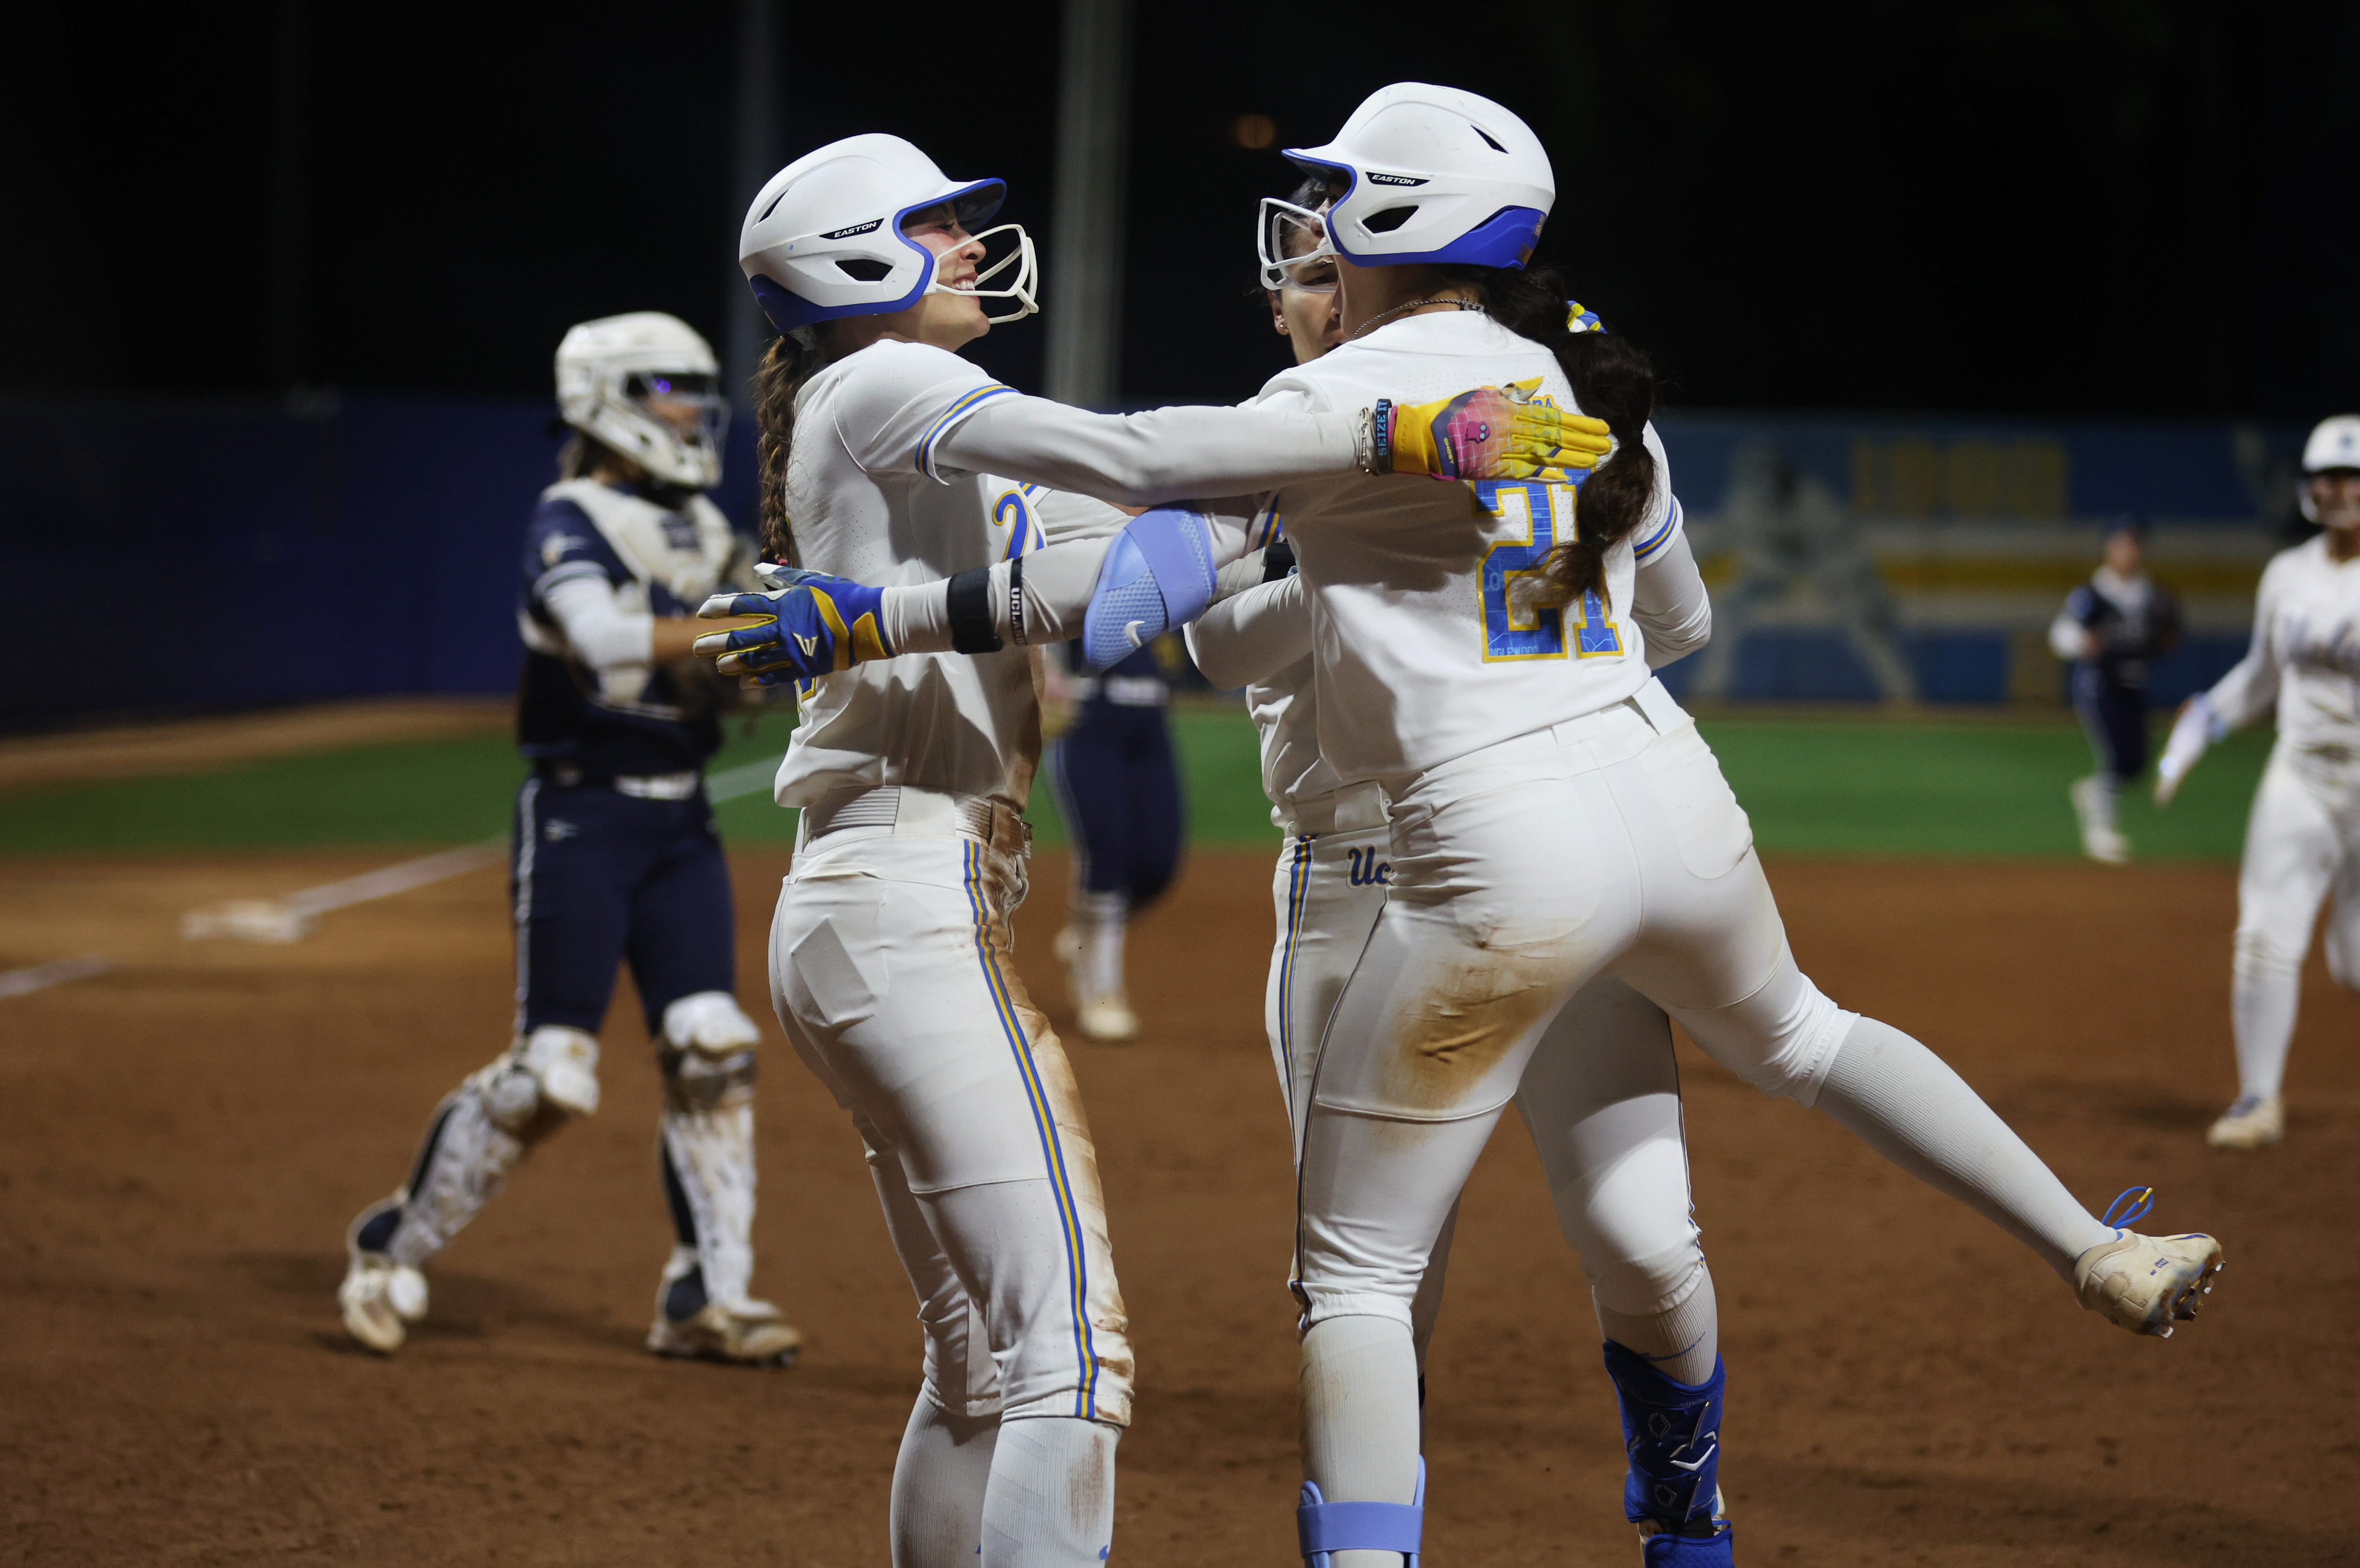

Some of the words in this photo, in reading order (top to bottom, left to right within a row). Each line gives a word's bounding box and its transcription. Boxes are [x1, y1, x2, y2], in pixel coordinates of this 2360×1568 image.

[1371, 174, 1416, 185] EASTON
[834, 221, 877, 238] EASTON
[1377, 401, 1388, 411] IT
[1376, 414, 1387, 457] SEIZE
[1444, 437, 1455, 465] GHOST
[1469, 463, 1624, 663] 21
